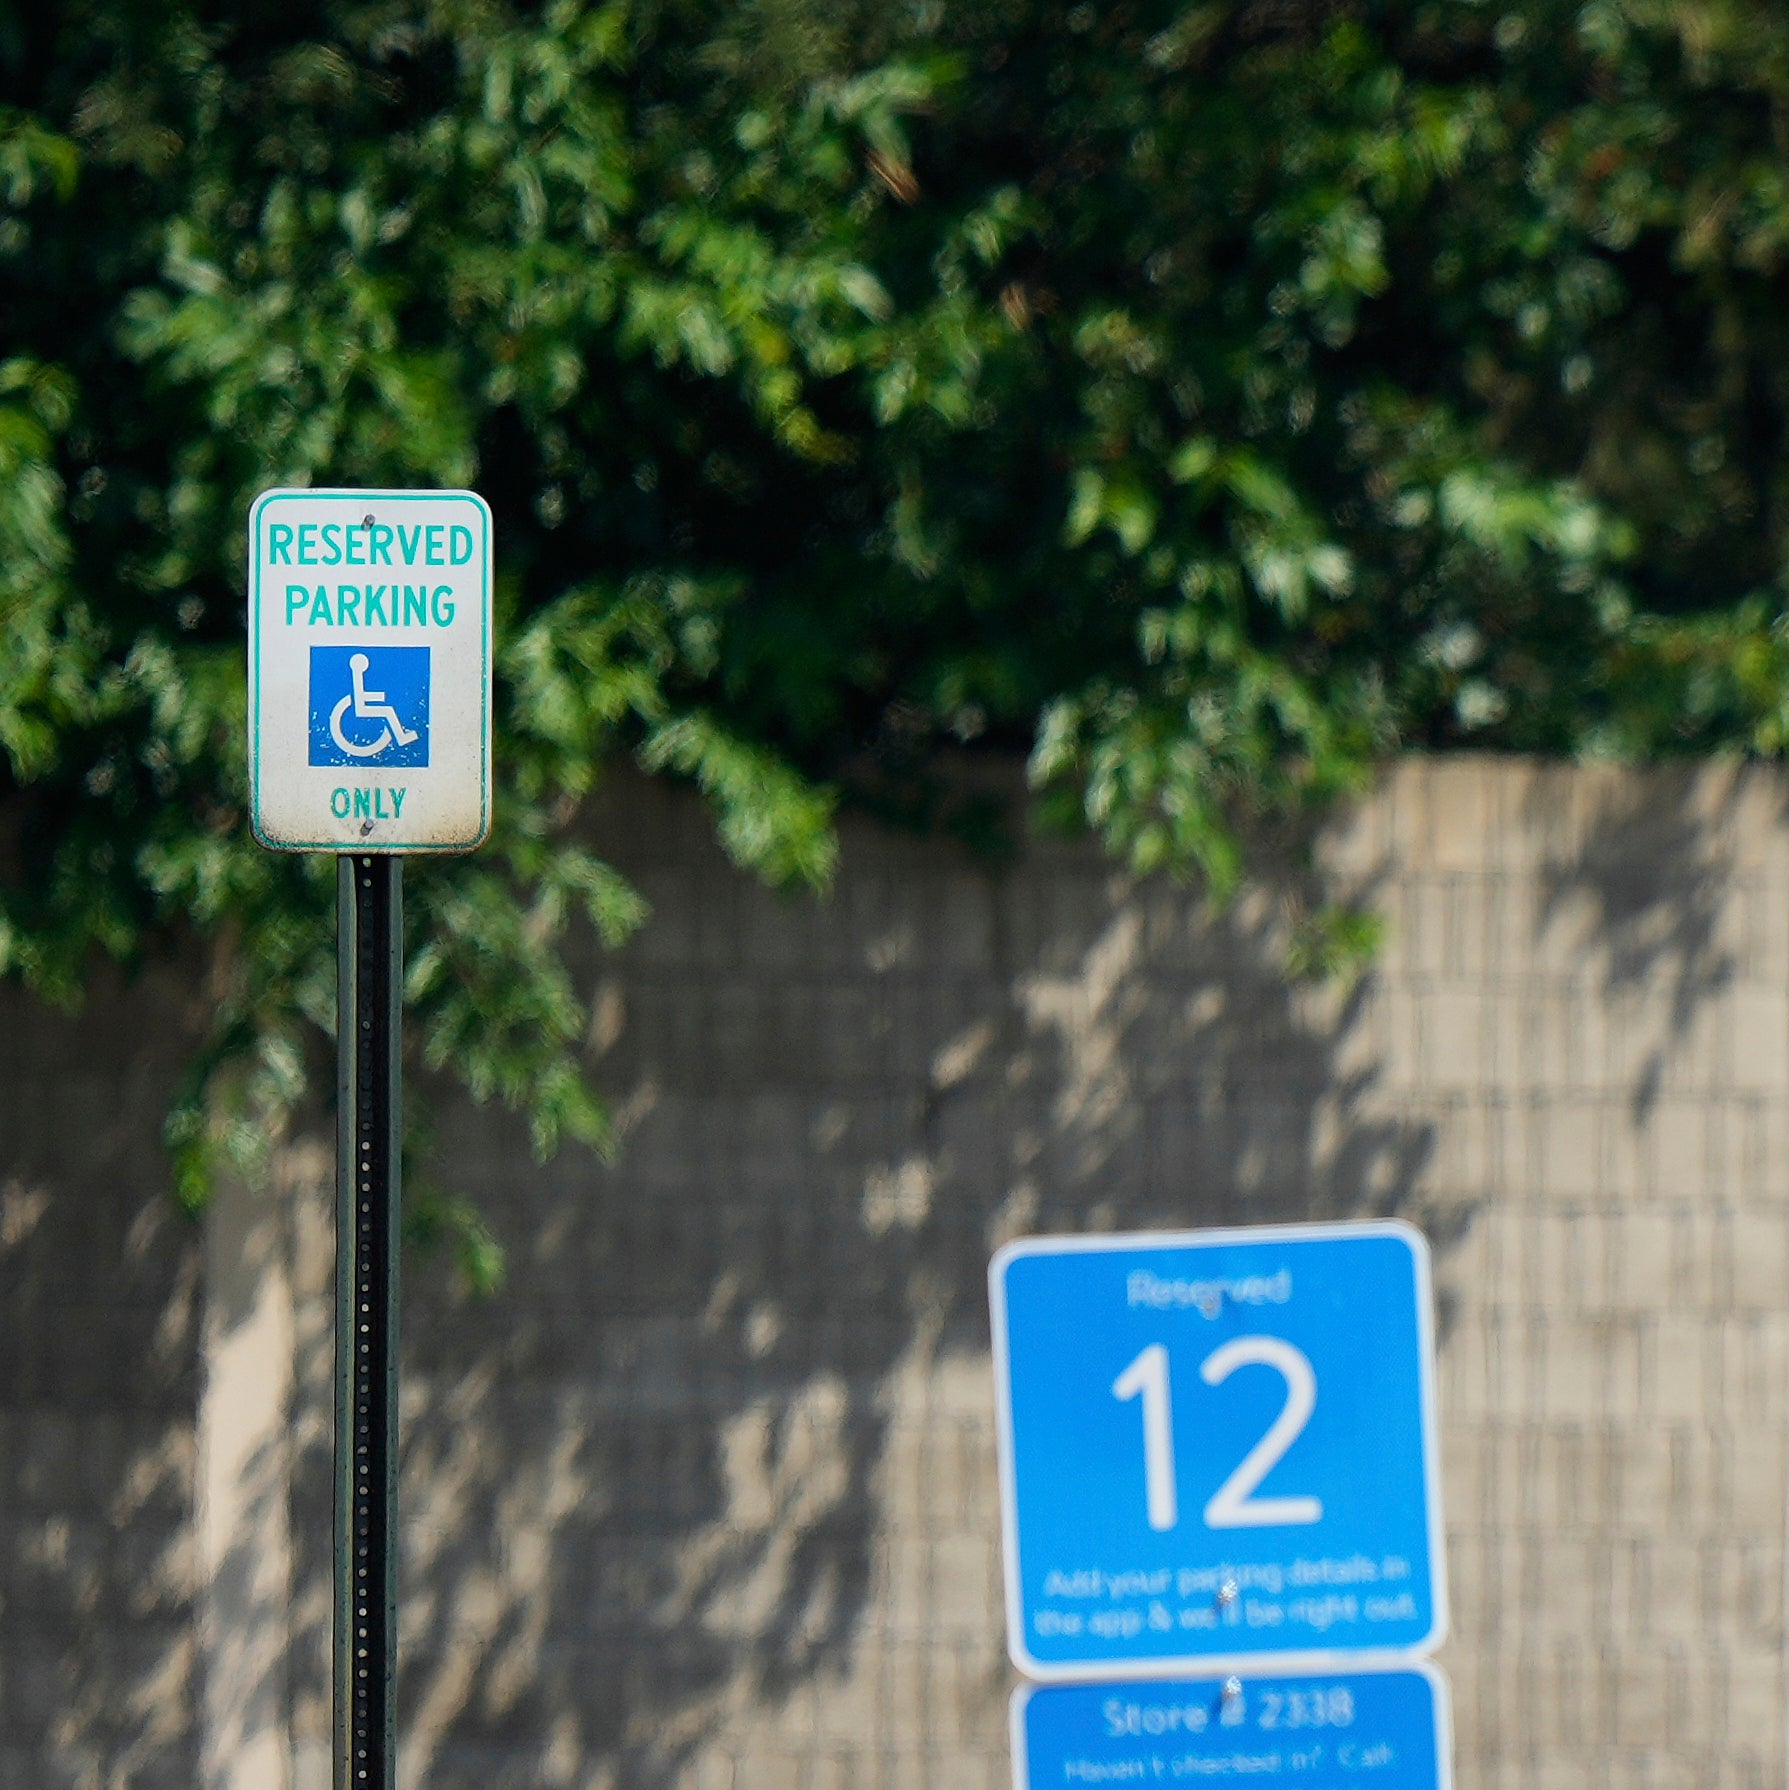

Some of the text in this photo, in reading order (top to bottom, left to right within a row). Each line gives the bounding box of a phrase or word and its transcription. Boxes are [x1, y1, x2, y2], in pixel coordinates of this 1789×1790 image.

[268, 523, 474, 567] RESERVED
[285, 584, 456, 628] PARKING
[330, 786, 407, 820] ONLY
[1126, 1269, 1293, 1307] Reserved
[1112, 1334, 1324, 1531] 12
[1102, 1694, 1209, 1737] Store
[1259, 1685, 1354, 1731] 2338
